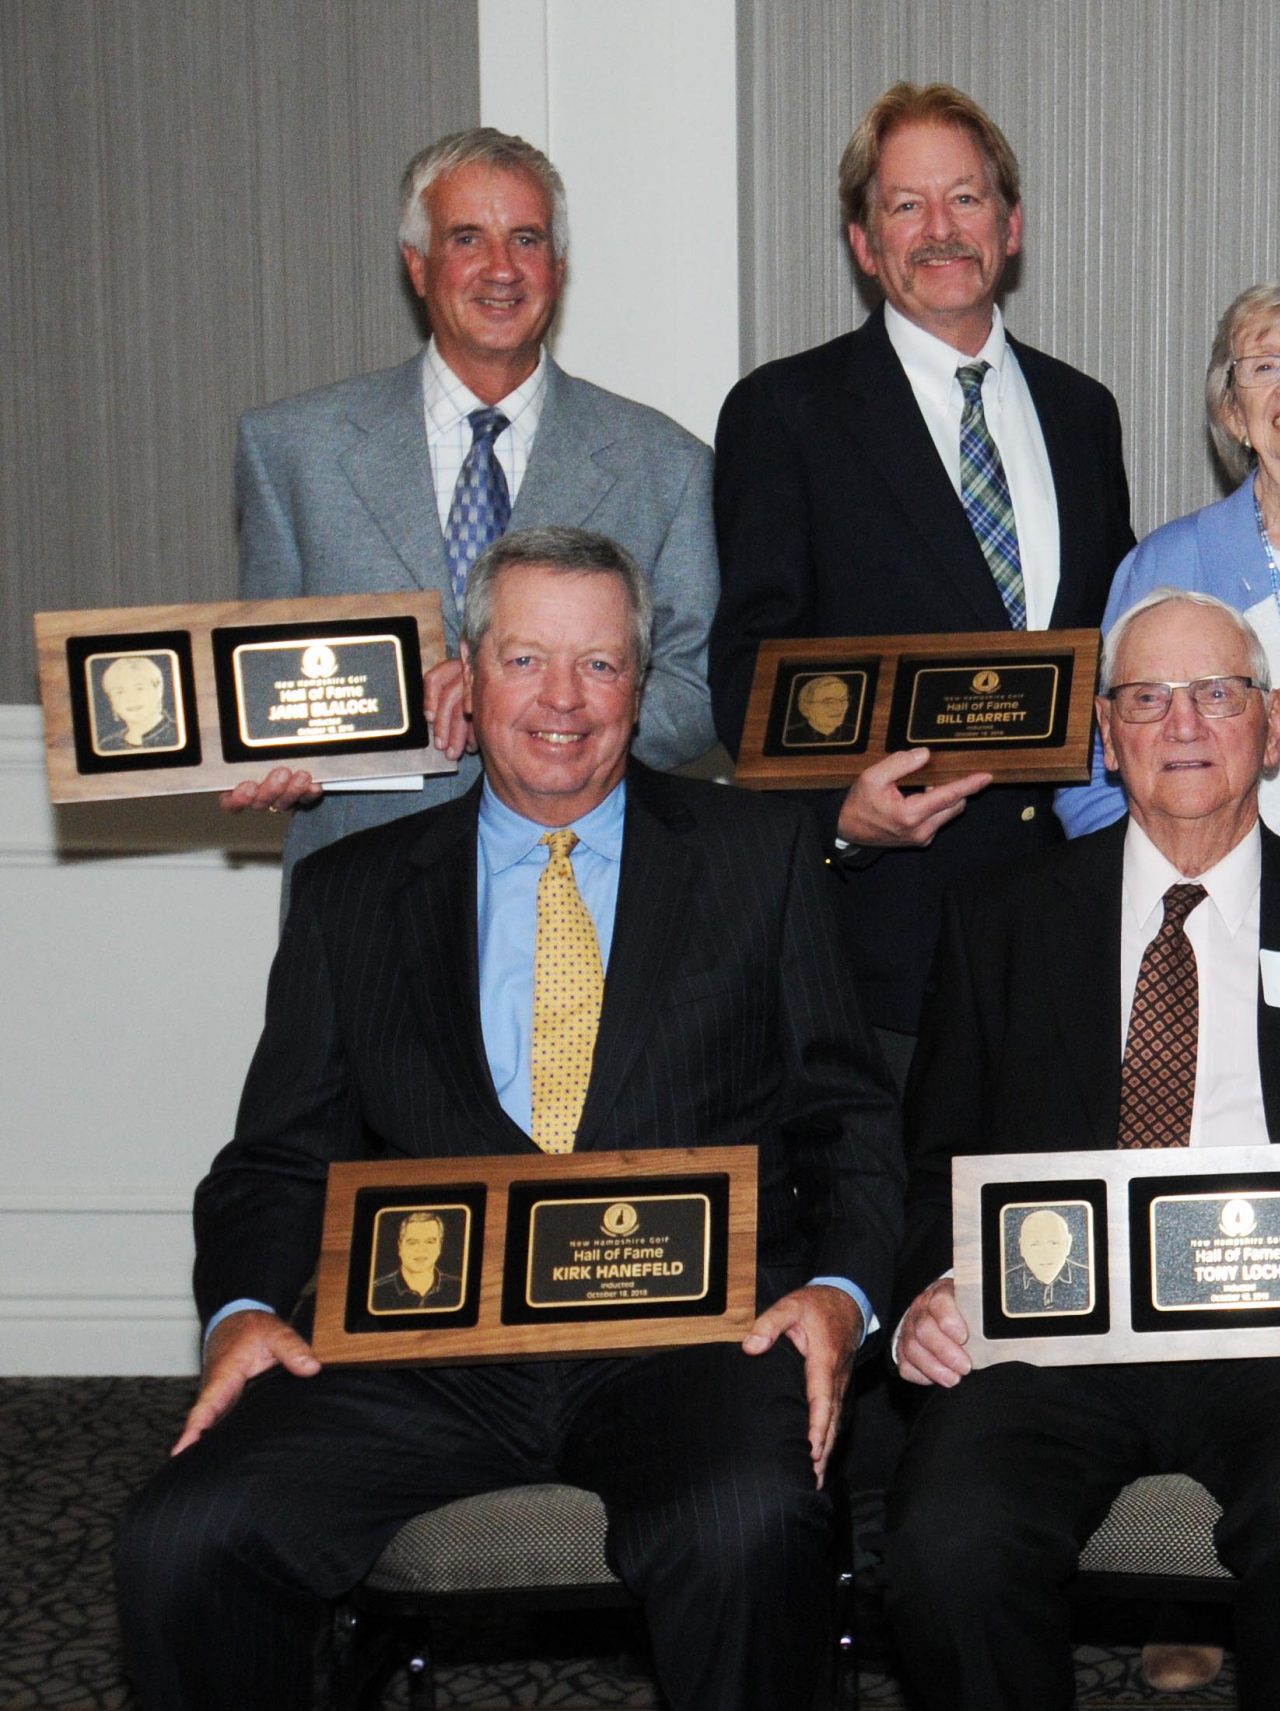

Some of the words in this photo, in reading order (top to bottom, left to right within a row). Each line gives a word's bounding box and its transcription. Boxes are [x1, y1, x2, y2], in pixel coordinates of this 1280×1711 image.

[280, 688, 306, 702] Hall
[308, 688, 324, 700] of
[326, 686, 363, 699] Fame
[947, 702, 968, 711] Hall
[971, 702, 984, 710] of
[987, 700, 1018, 710] Fame
[937, 714, 963, 724] BILL
[967, 712, 1026, 723] BARRETT
[594, 1238, 645, 1246] Hampshire
[649, 1236, 669, 1244] Golf
[574, 1250, 600, 1262] Hall
[604, 1249, 620, 1260] of
[623, 1247, 664, 1259] Fame
[1195, 1250, 1221, 1263] Hall
[1225, 1249, 1240, 1262] of
[1243, 1247, 1280, 1261] Fame
[553, 1265, 591, 1281] KIRK
[596, 1262, 683, 1278] HANEFELD
[1194, 1266, 1239, 1282] TONY
